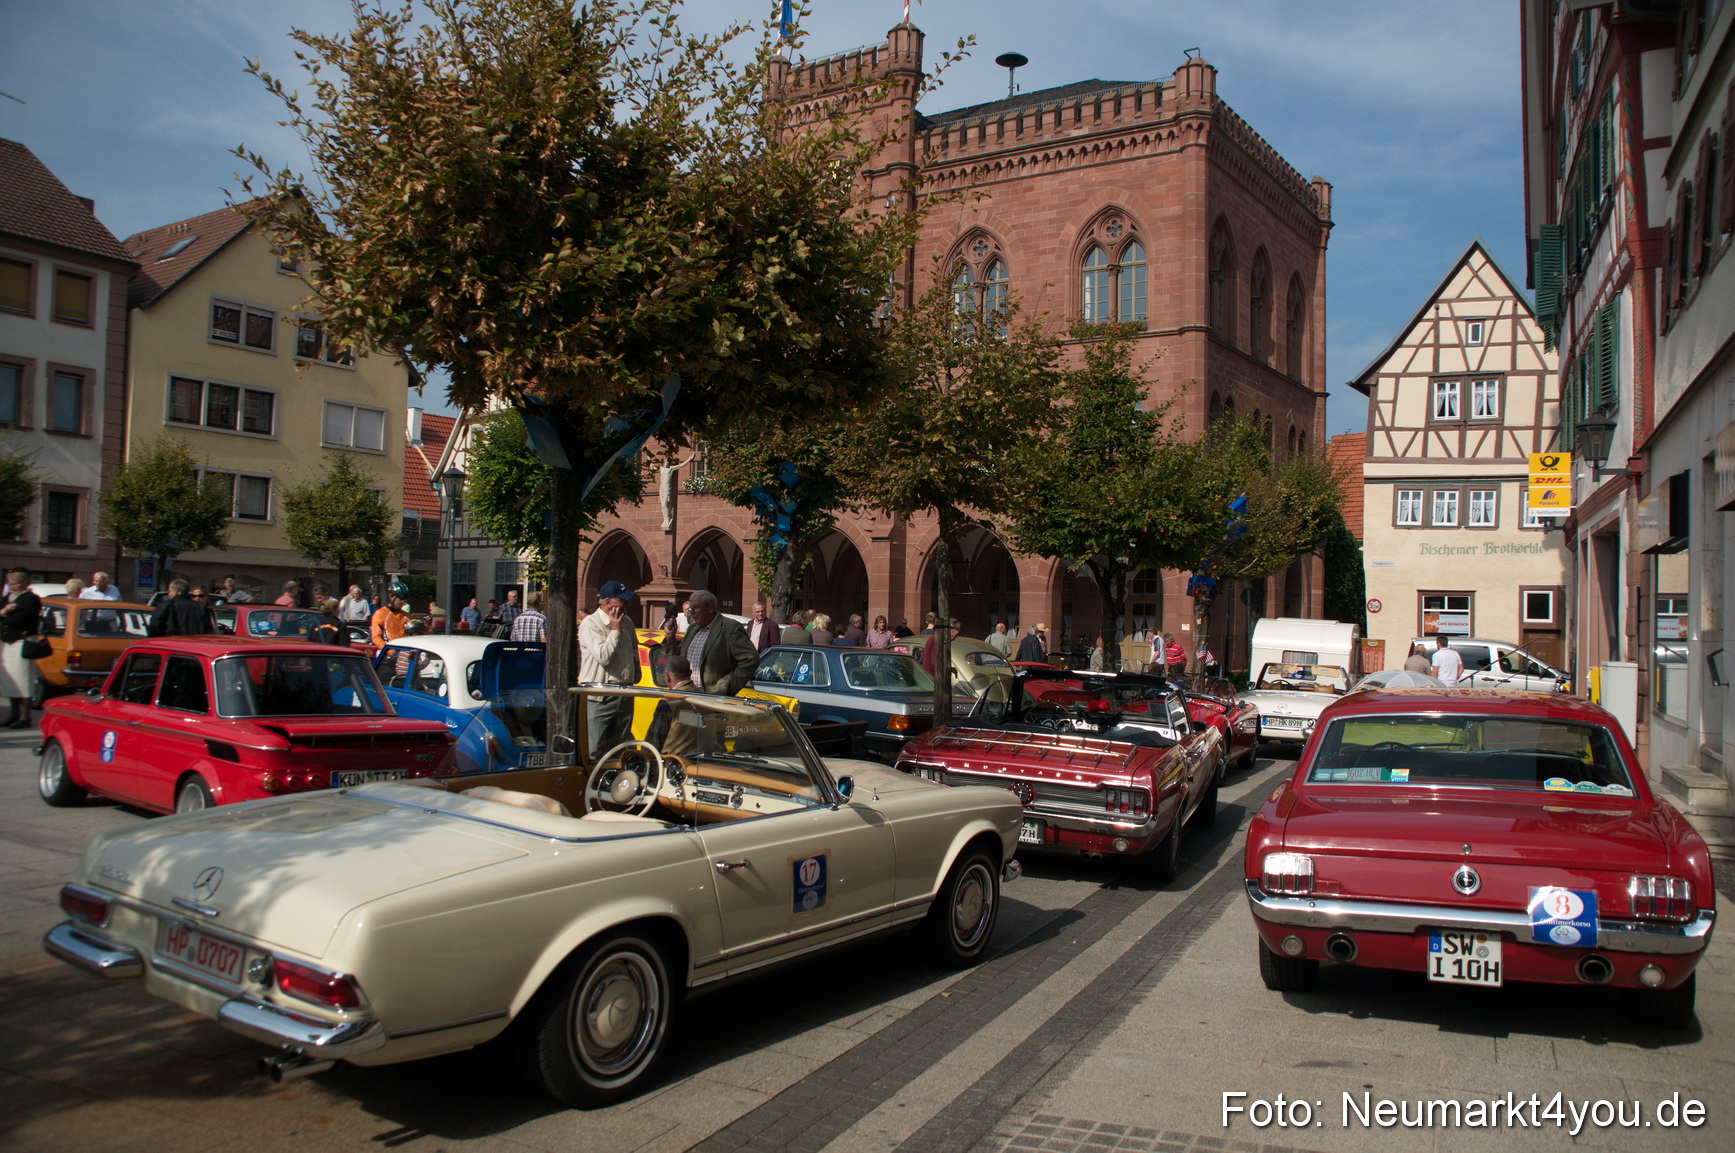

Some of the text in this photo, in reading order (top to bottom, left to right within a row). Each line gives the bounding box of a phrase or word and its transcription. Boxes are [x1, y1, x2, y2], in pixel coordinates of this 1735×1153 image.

[1419, 542, 1478, 556] Bischemer
[528, 755, 545, 766] TBB
[339, 772, 365, 787] KÜN
[802, 862, 817, 882] 17
[1555, 894, 1570, 915] 8
[167, 927, 240, 975] HP 0707
[1443, 933, 1475, 955] SW
[1432, 956, 1500, 982] I 10H
